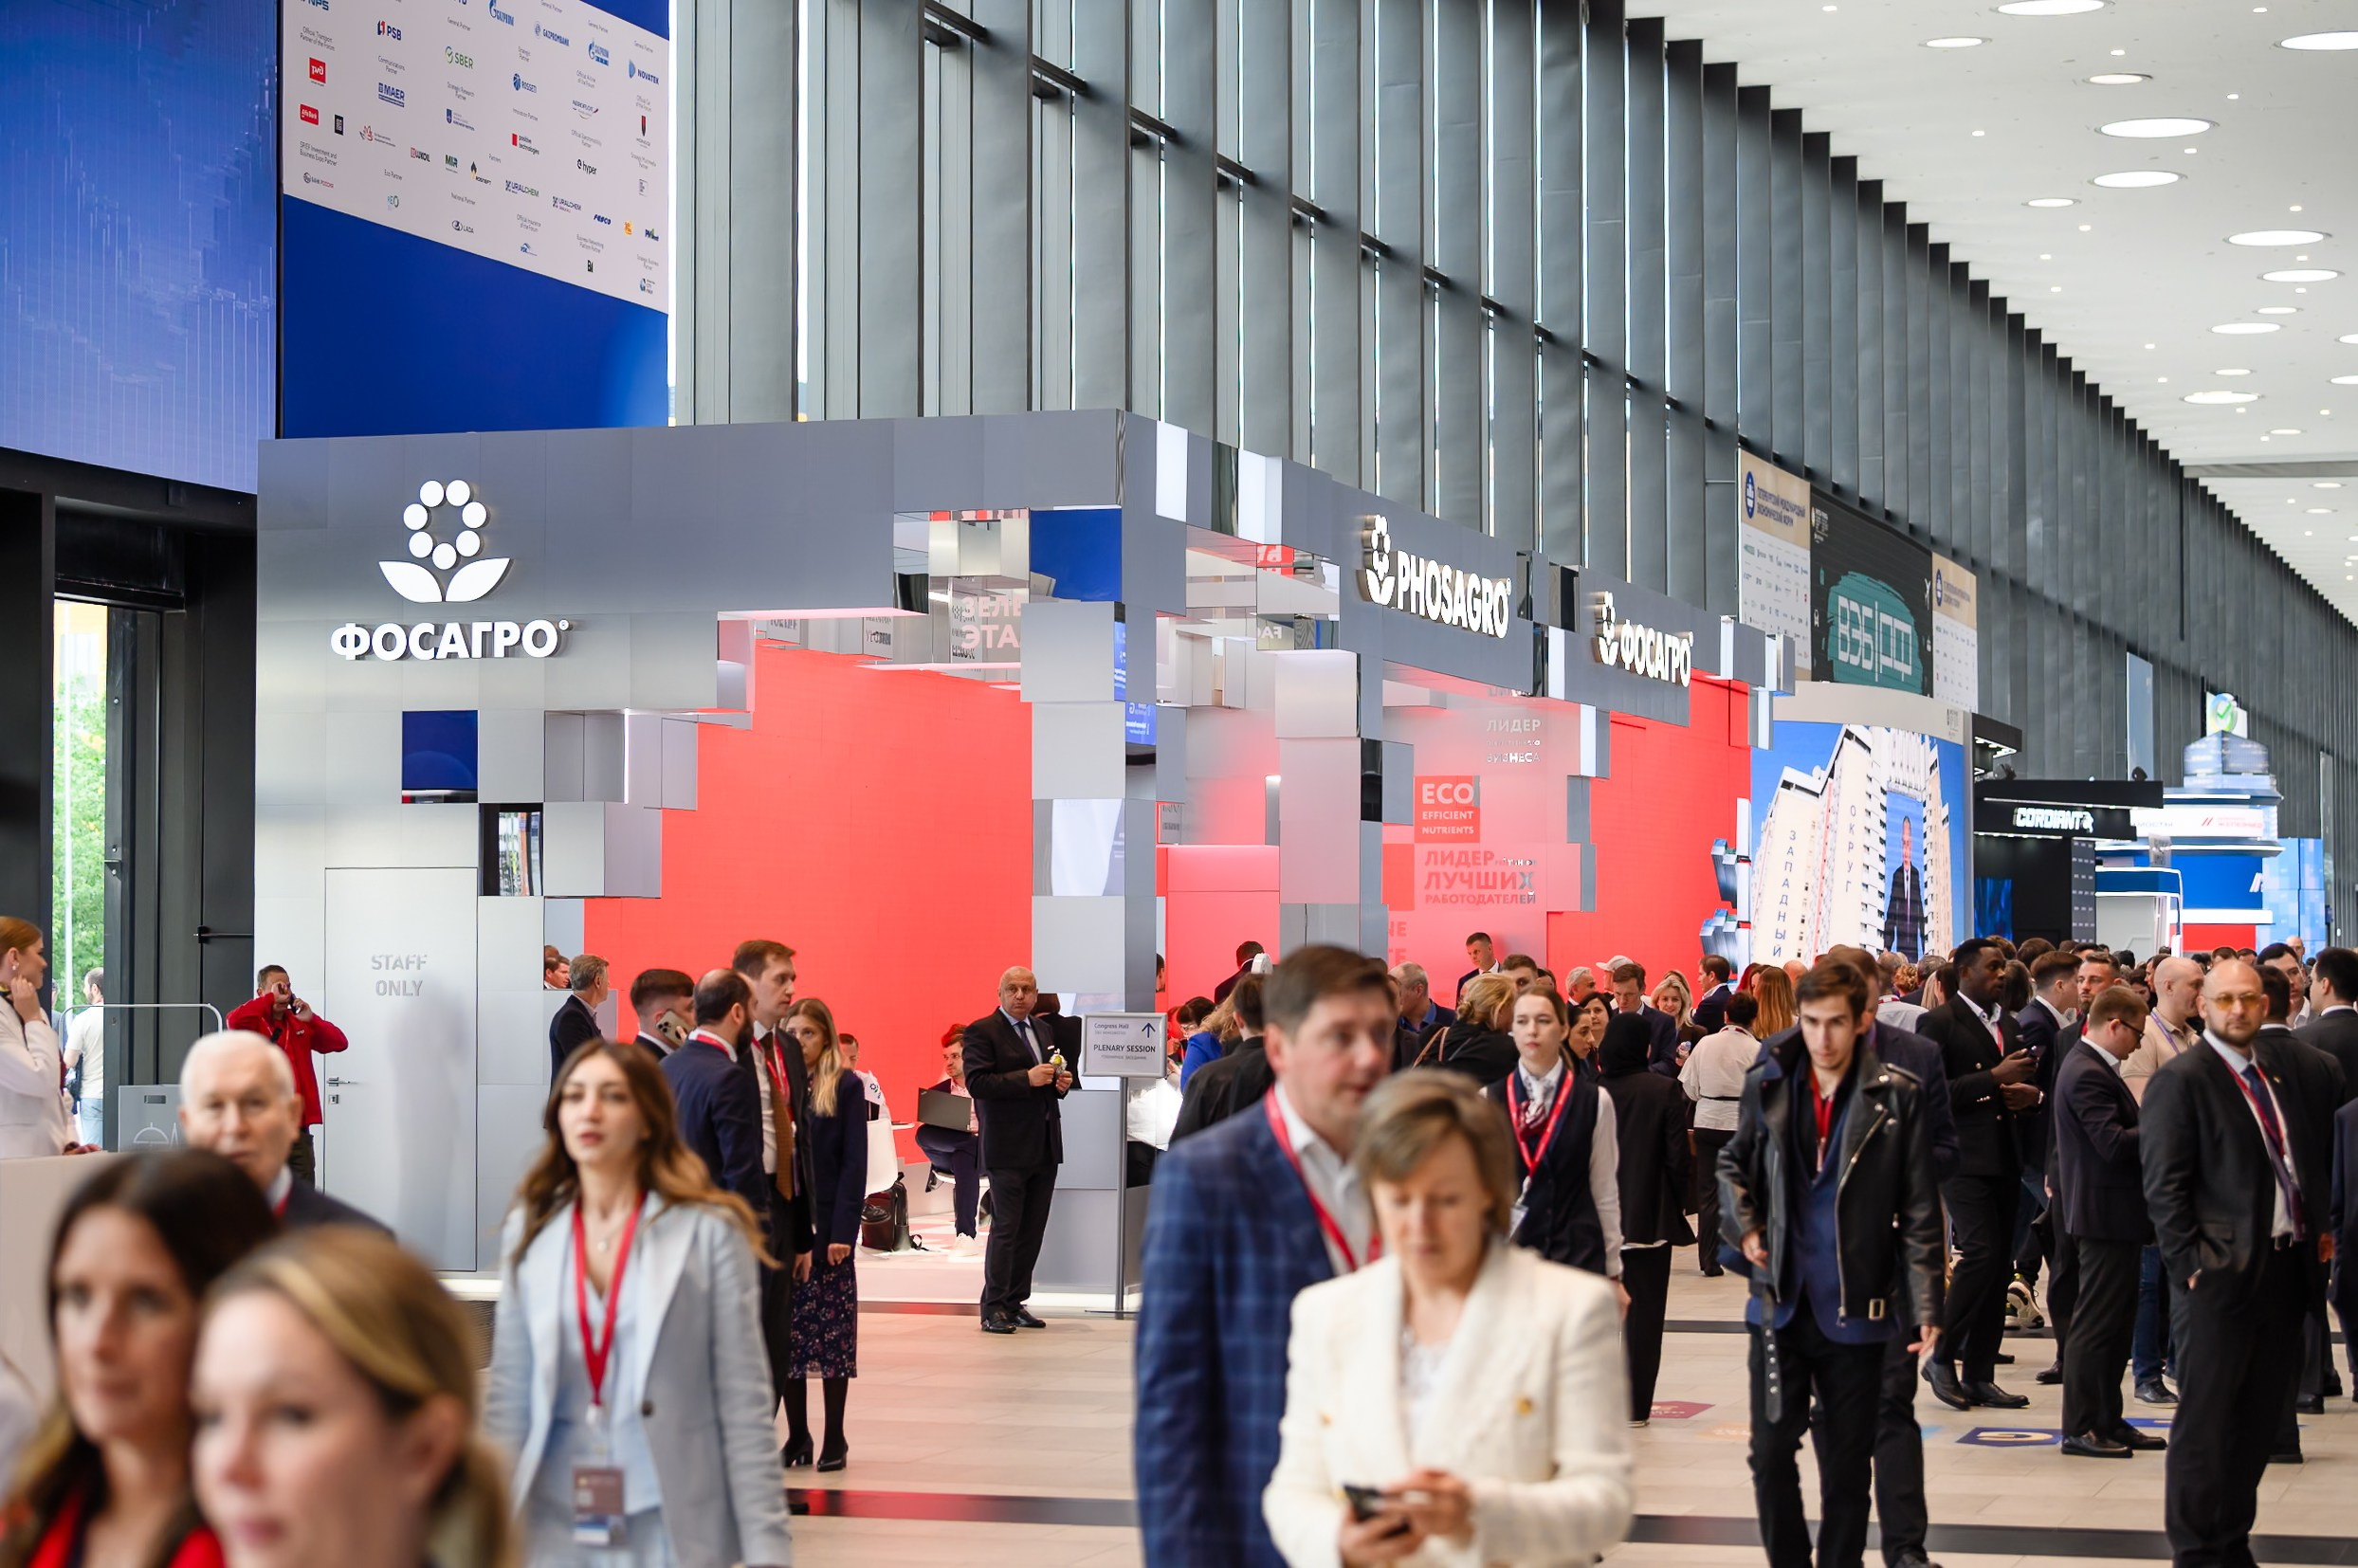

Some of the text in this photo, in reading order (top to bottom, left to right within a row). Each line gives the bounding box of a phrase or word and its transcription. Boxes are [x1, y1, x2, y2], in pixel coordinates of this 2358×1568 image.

[387, 25, 402, 41] PSB
[454, 52, 474, 70] SBER
[637, 68, 660, 85] NOVATEK
[582, 160, 596, 175] hyper
[593, 213, 612, 226] FESCO
[1396, 550, 1509, 639] PHOSAGRO
[330, 619, 559, 662] ФОСАГРО
[1619, 618, 1692, 687] ФОСАГРО
[1487, 719, 1542, 734] ЛИДЕР
[1422, 783, 1474, 804] ECO
[1422, 811, 1474, 820] EFFICIENT
[2016, 807, 2083, 830] CORDIANT
[1422, 826, 1474, 834] NUTRIENTS
[1425, 850, 1495, 867] ЛИДЕР
[1424, 871, 1534, 890] ЛУЧШИХ
[1425, 891, 1536, 904] РАБОТОДАТЕЛЕЙ
[371, 954, 428, 971] STAFF
[375, 979, 424, 996] ONLY
